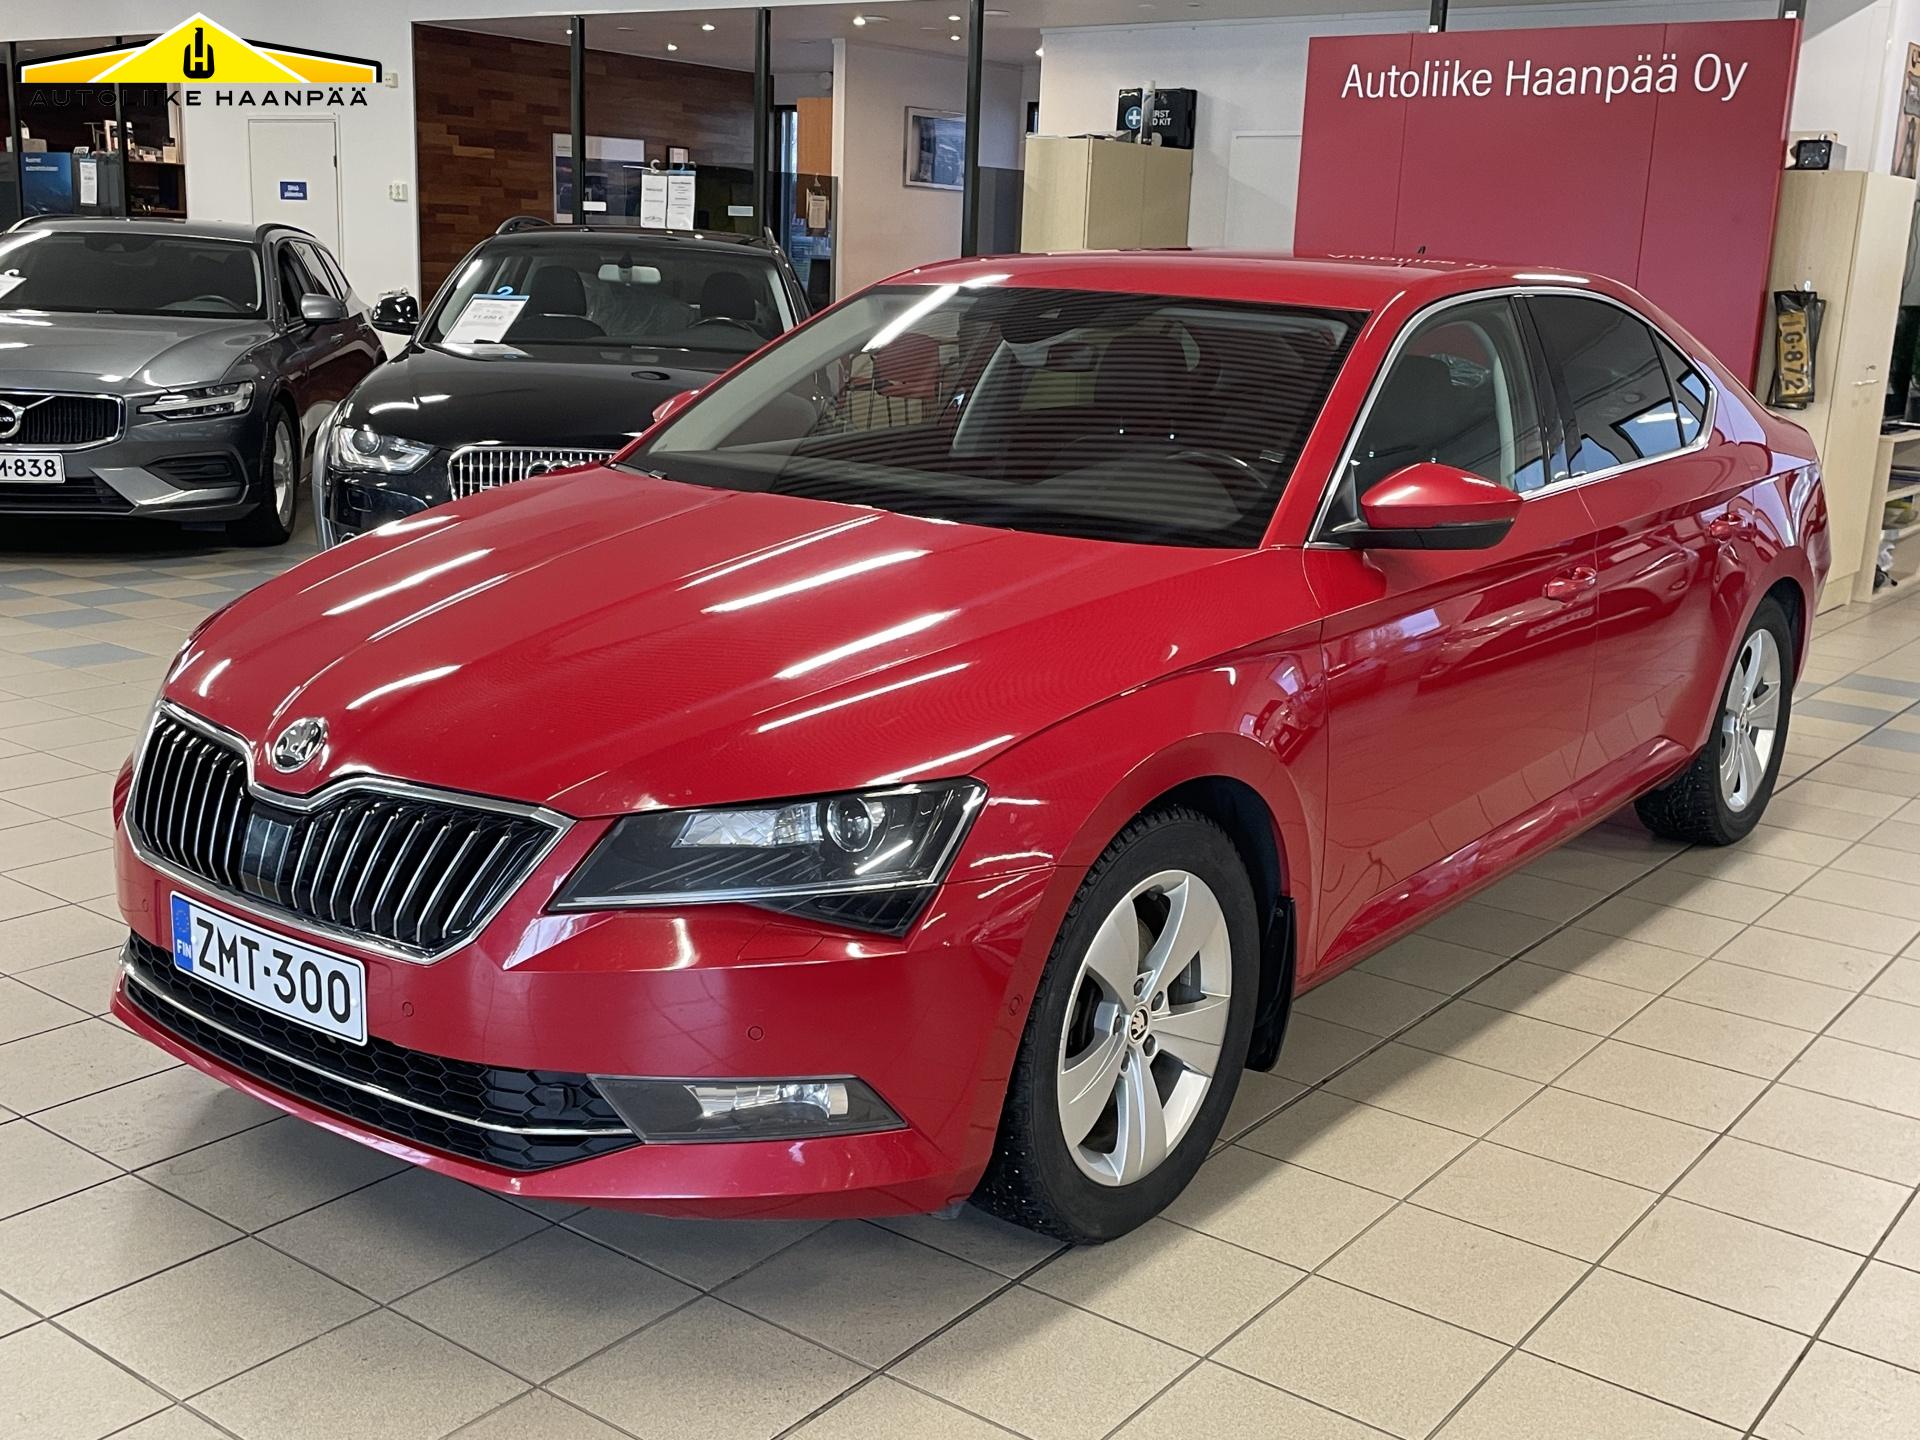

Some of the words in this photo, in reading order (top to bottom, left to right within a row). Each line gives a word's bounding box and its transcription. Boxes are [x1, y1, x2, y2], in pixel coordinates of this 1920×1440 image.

[1340, 60, 1493, 99] Autoliike
[1505, 53, 1678, 104] Haanpää
[1694, 53, 1749, 102] Oy
[1159, 117, 1172, 126] KIT
[176, 939, 193, 959] FIN
[196, 916, 351, 1024] ZMT-300
